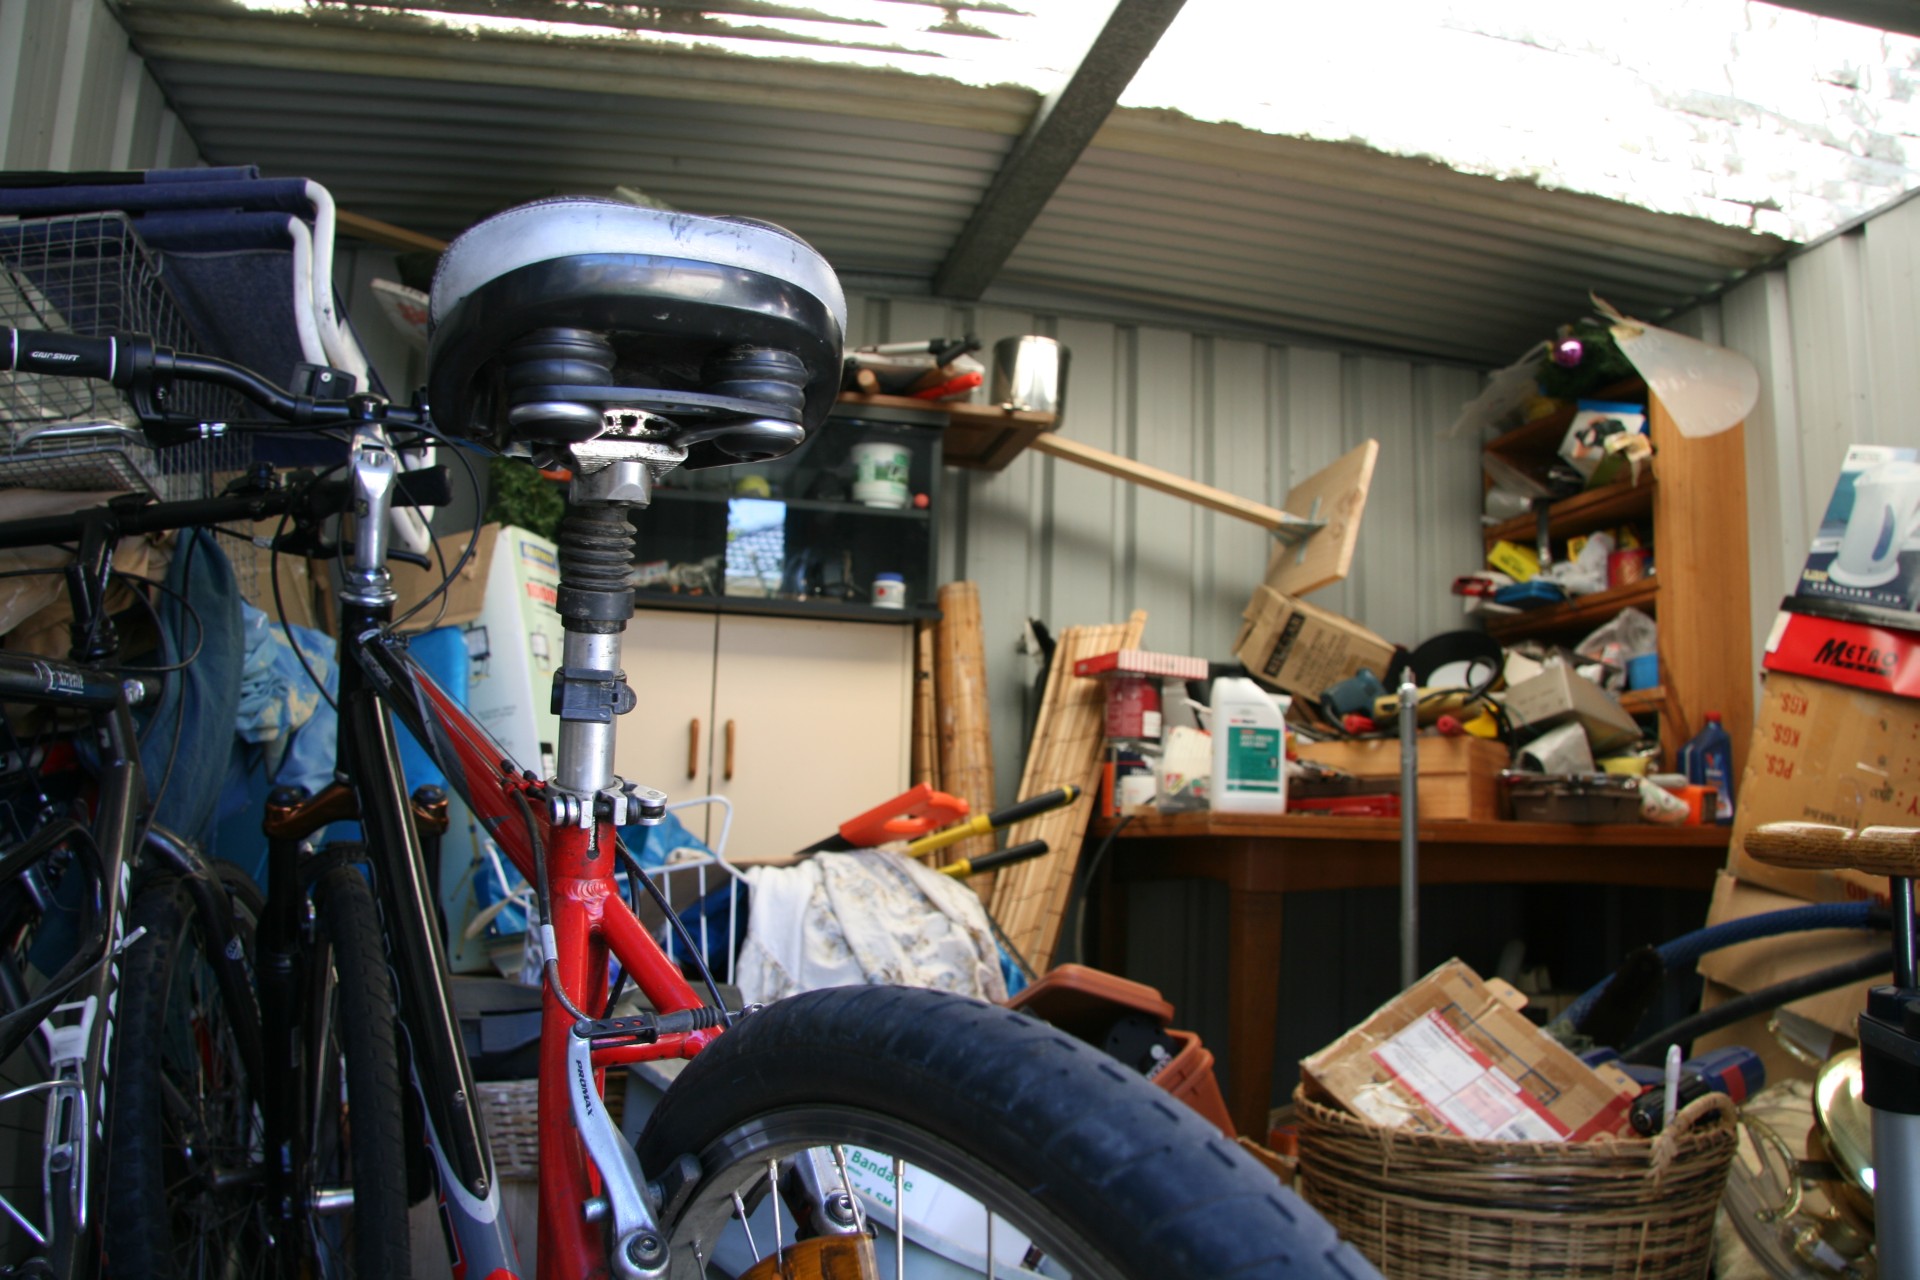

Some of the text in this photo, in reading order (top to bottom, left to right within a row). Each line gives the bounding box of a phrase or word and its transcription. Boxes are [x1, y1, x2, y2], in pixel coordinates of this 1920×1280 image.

[1812, 582, 1901, 603] CORDLESS JUG
[1781, 692, 1809, 716] KGS.
[1772, 722, 1801, 748] KGS.
[1766, 753, 1794, 780] PCS.
[576, 1059, 594, 1117] PROMAX
